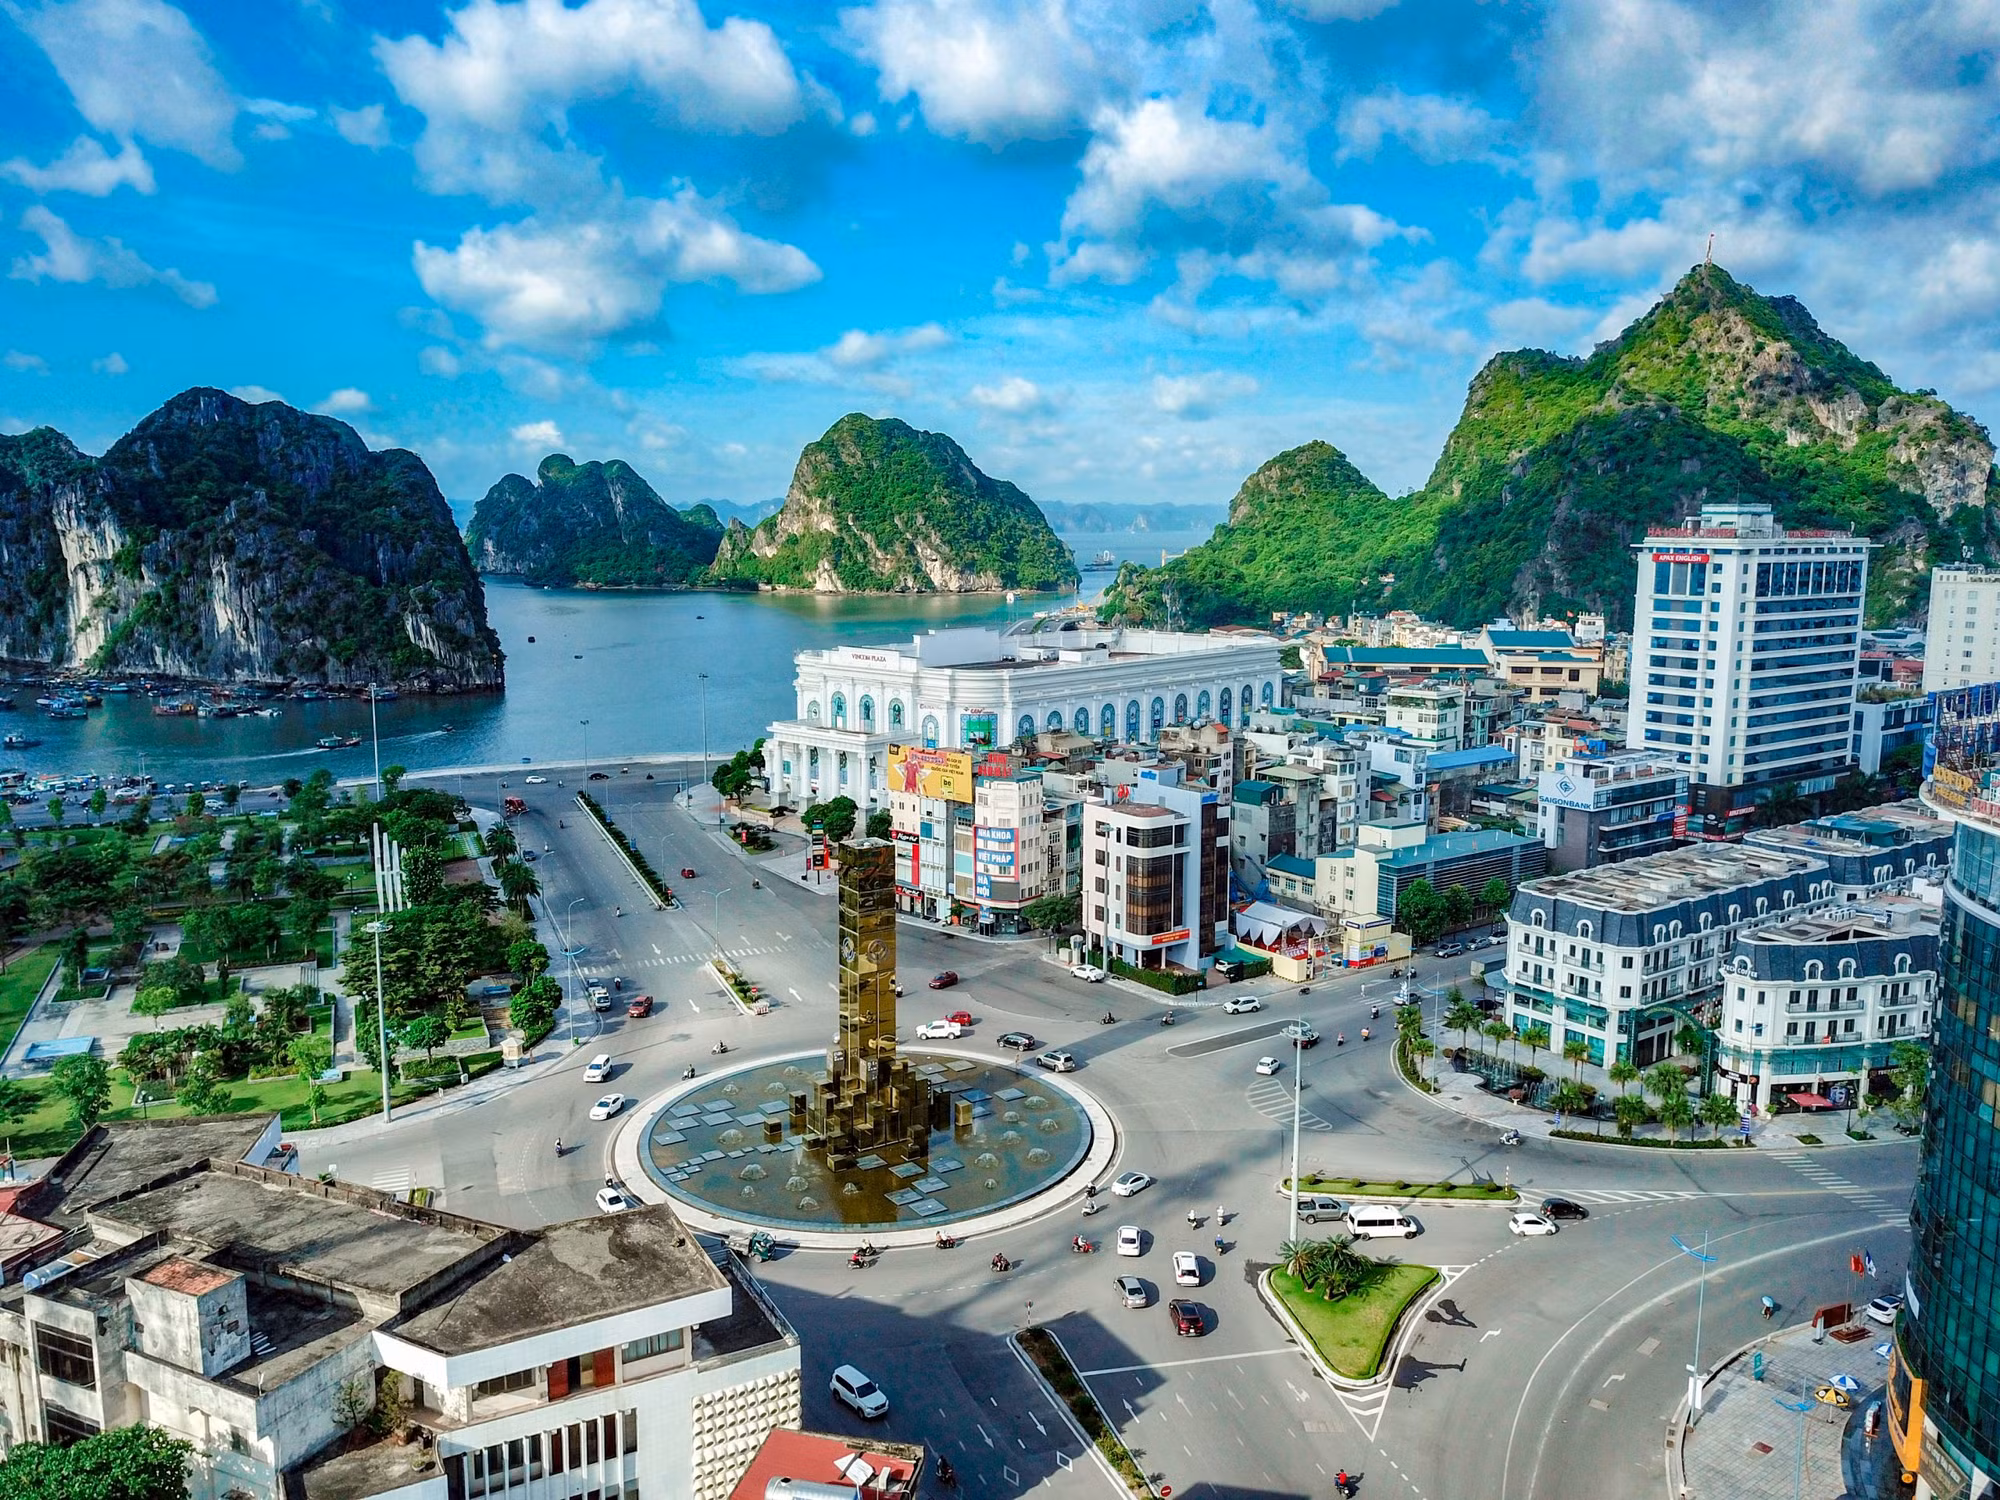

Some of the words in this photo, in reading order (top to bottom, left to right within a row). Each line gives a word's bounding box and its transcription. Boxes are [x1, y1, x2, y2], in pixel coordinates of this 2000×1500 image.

[1539, 795, 1592, 810] SAIGONBANK
[977, 828, 990, 838] NHA
[991, 830, 1011, 840] KHOA
[978, 851, 990, 862] VIỆT
[991, 853, 1011, 863] PHÁP
[977, 886, 990, 897] NỘI
[1737, 968, 1758, 978] COFFEE
